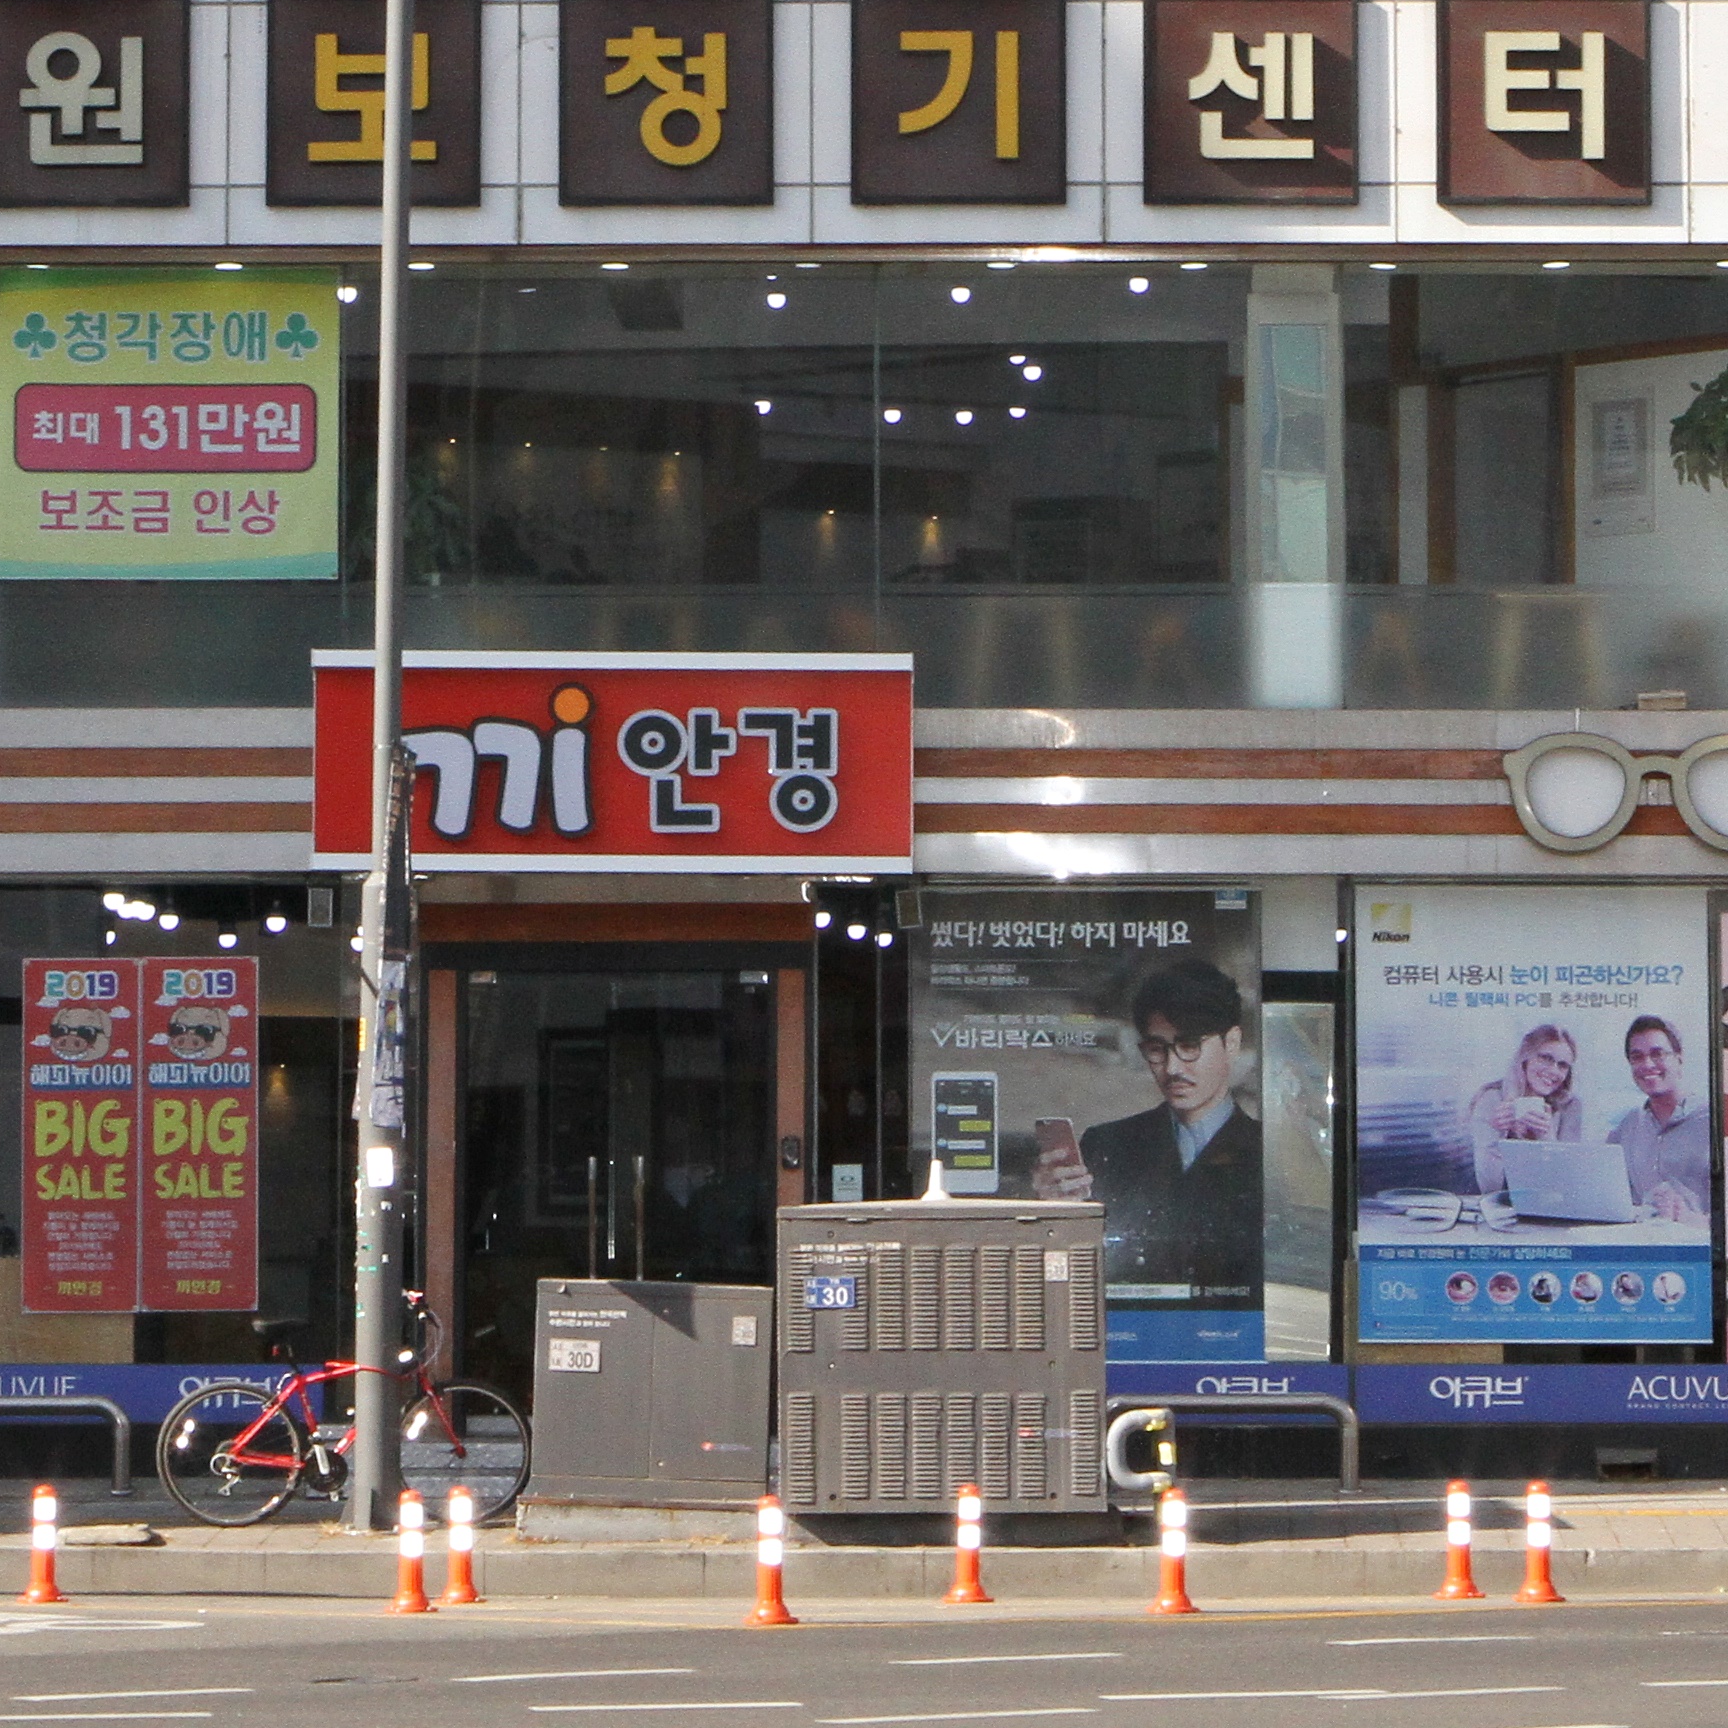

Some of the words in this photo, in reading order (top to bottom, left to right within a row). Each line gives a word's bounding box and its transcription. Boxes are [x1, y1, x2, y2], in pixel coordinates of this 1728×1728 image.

[62, 312, 270, 364] 청각장애
[32, 411, 101, 445] 최대
[113, 401, 303, 455] 131만원
[38, 488, 171, 535] 보조금
[193, 487, 281, 536] 인상
[616, 708, 839, 833] 안경
[988, 921, 1065, 948] 벗었다!
[1071, 921, 1116, 948] 하지
[1123, 921, 1192, 948] 마세요
[1372, 931, 1410, 942] Nikon
[45, 971, 119, 1001] 2019
[162, 969, 237, 999] 2019
[1383, 965, 1439, 985] 컴퓨터
[1446, 964, 1504, 986] 사용시
[1510, 964, 1549, 986] 눈이
[1555, 964, 1685, 986] 피곤하신가요?
[1558, 992, 1639, 1009] 추천합니다!
[34, 1098, 131, 1158] BIG
[153, 1097, 249, 1156] BIG
[35, 1163, 127, 1200] SALE
[154, 1162, 245, 1198] SALE
[822, 1286, 849, 1306] 30
[567, 1350, 594, 1369] 30D
[1428, 1375, 1526, 1407] 아큐브
